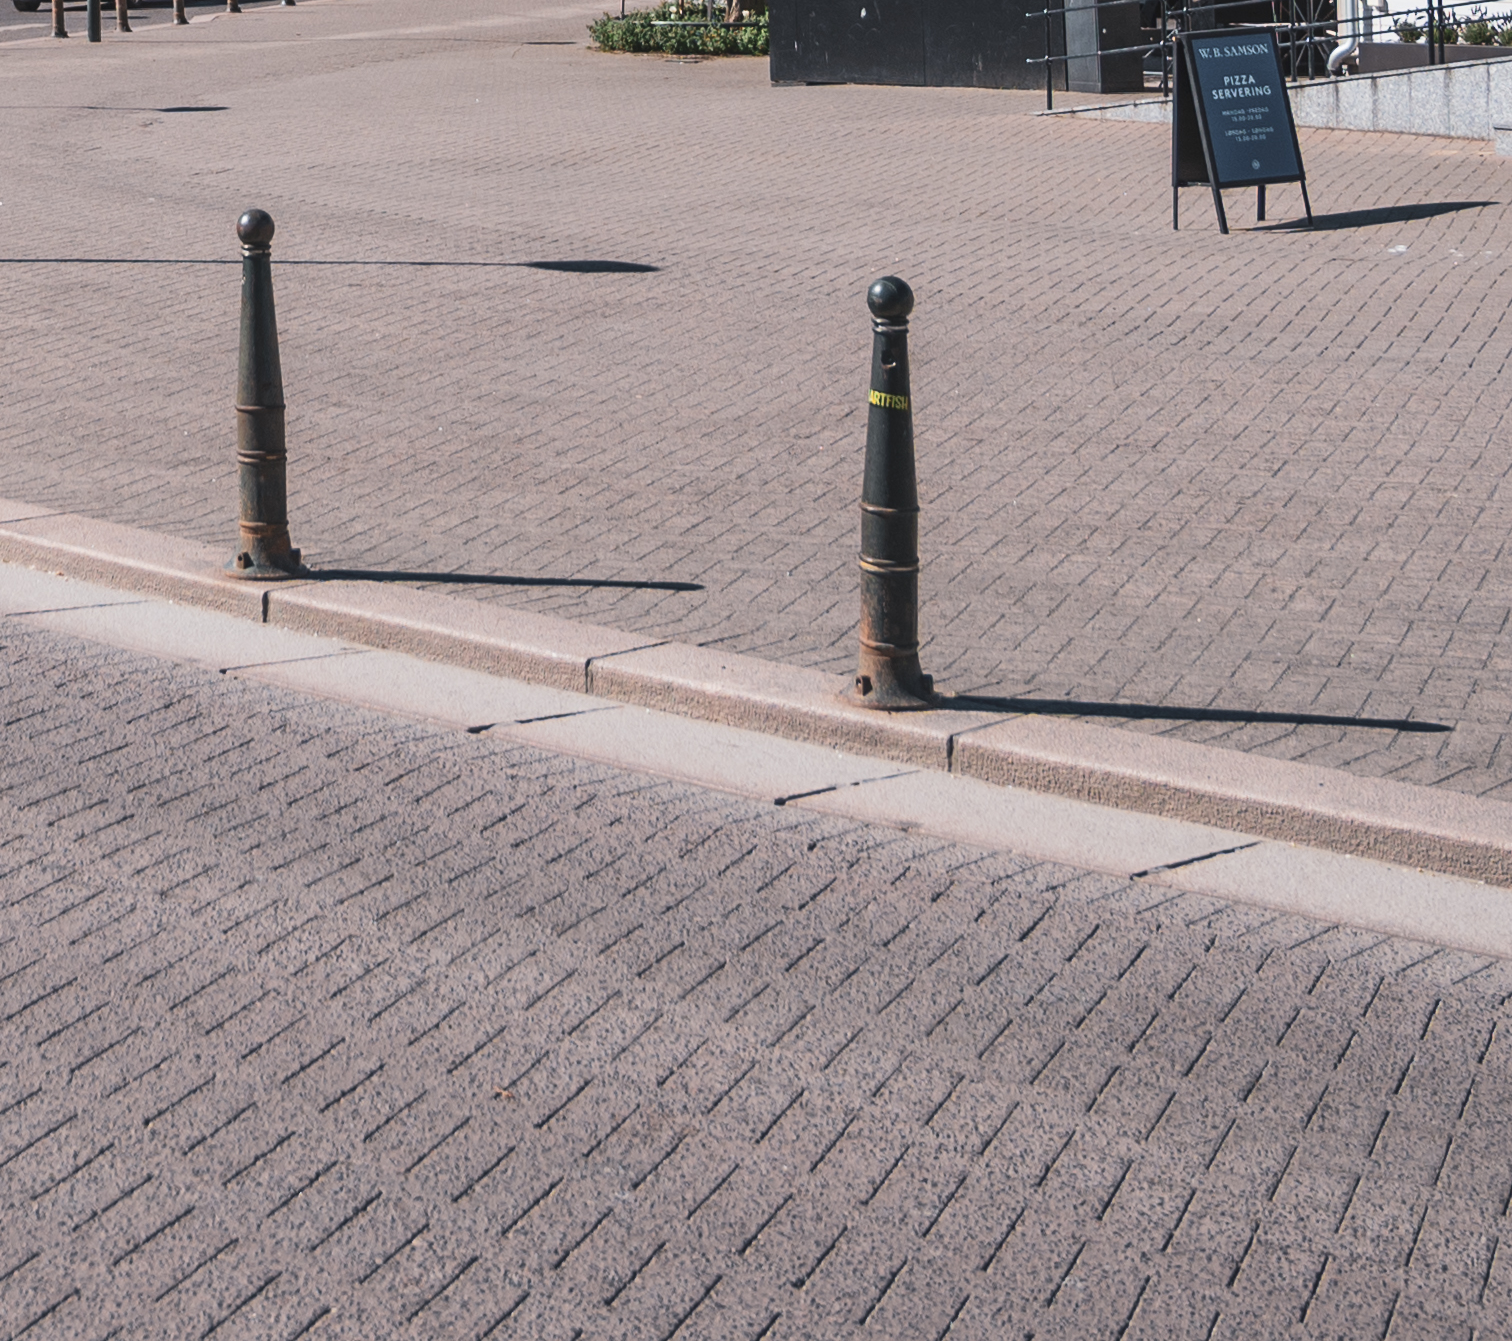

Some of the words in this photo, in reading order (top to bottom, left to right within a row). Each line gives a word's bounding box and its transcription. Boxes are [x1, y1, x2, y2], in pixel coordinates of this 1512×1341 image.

[1224, 43, 1269, 57] SAMSON
[1223, 74, 1256, 86] PIZZA
[1212, 85, 1271, 100] SERVERING
